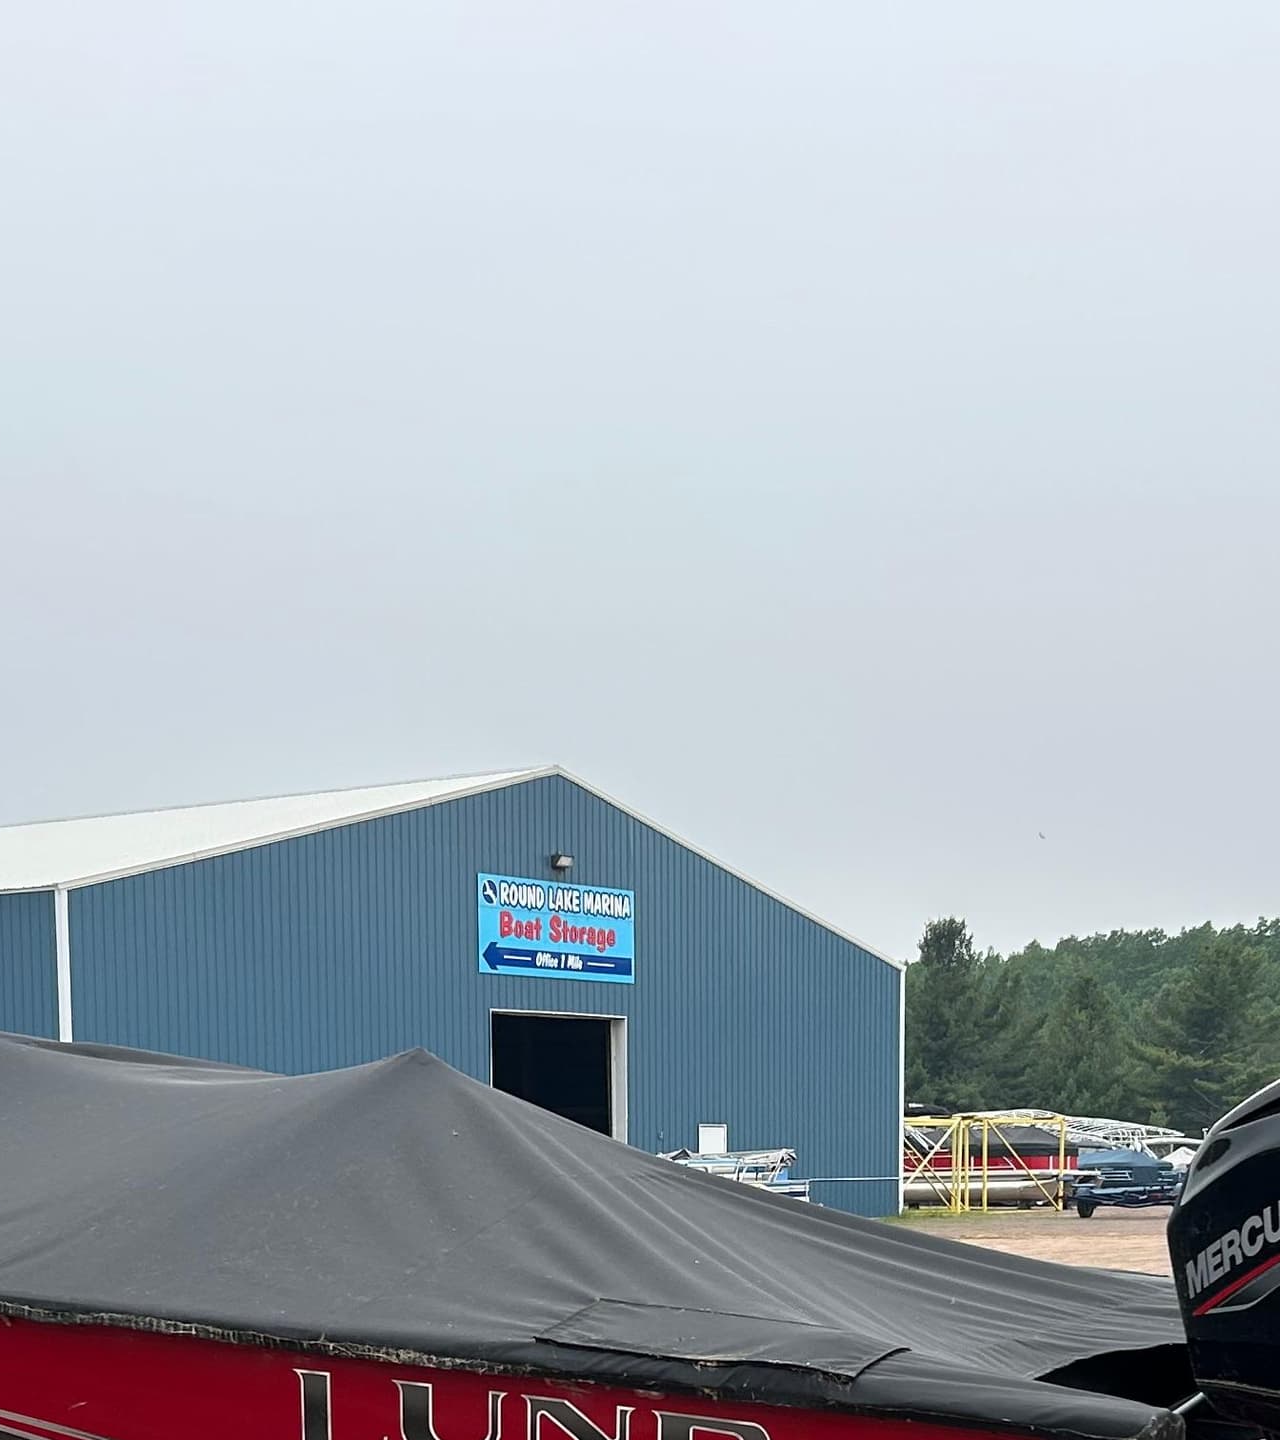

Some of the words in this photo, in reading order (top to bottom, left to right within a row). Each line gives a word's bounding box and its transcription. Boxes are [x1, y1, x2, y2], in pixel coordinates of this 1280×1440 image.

[499, 880, 545, 910] ROUND
[548, 885, 580, 913] LAKE
[583, 890, 631, 918] MARINA
[499, 911, 542, 941] Boat
[549, 915, 616, 952] Storage
[535, 951, 558, 968] Office
[560, 953, 566, 968] 1
